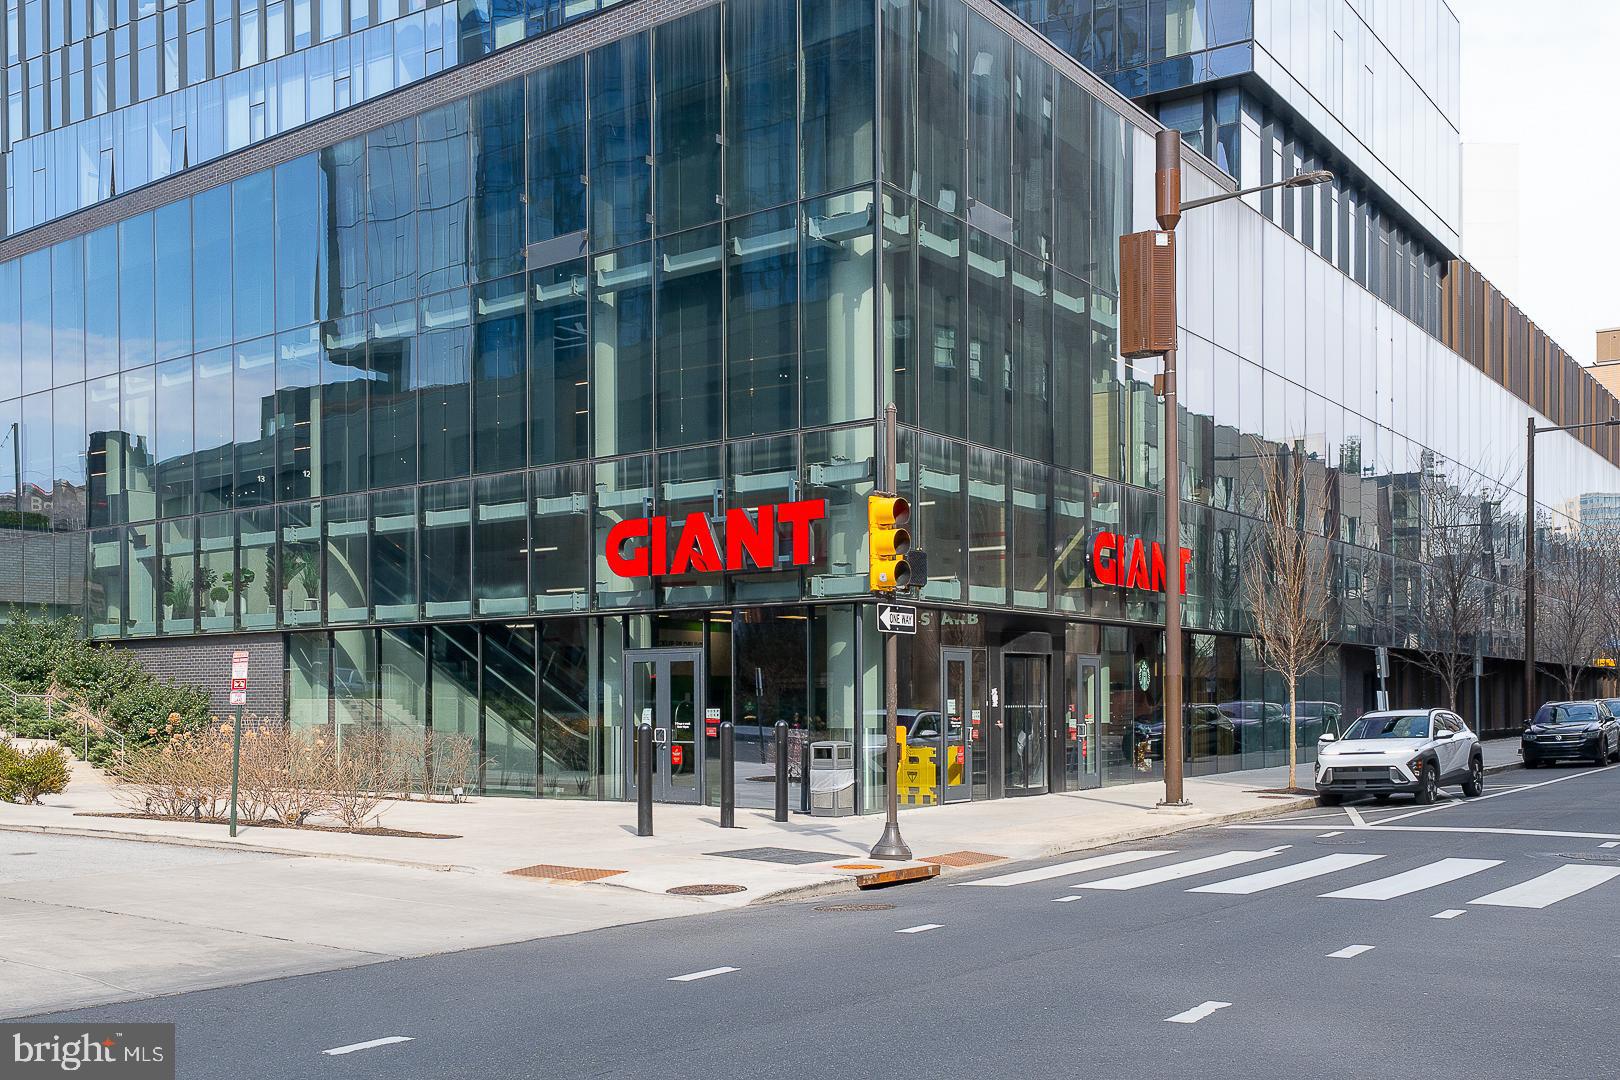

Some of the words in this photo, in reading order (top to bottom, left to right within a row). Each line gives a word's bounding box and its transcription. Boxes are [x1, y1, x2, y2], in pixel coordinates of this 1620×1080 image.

[256, 475, 266, 483] 13
[605, 498, 827, 578] GIANT
[889, 613, 901, 624] ONE
[901, 613, 912, 625] WAY
[920, 612, 979, 626] SAB
